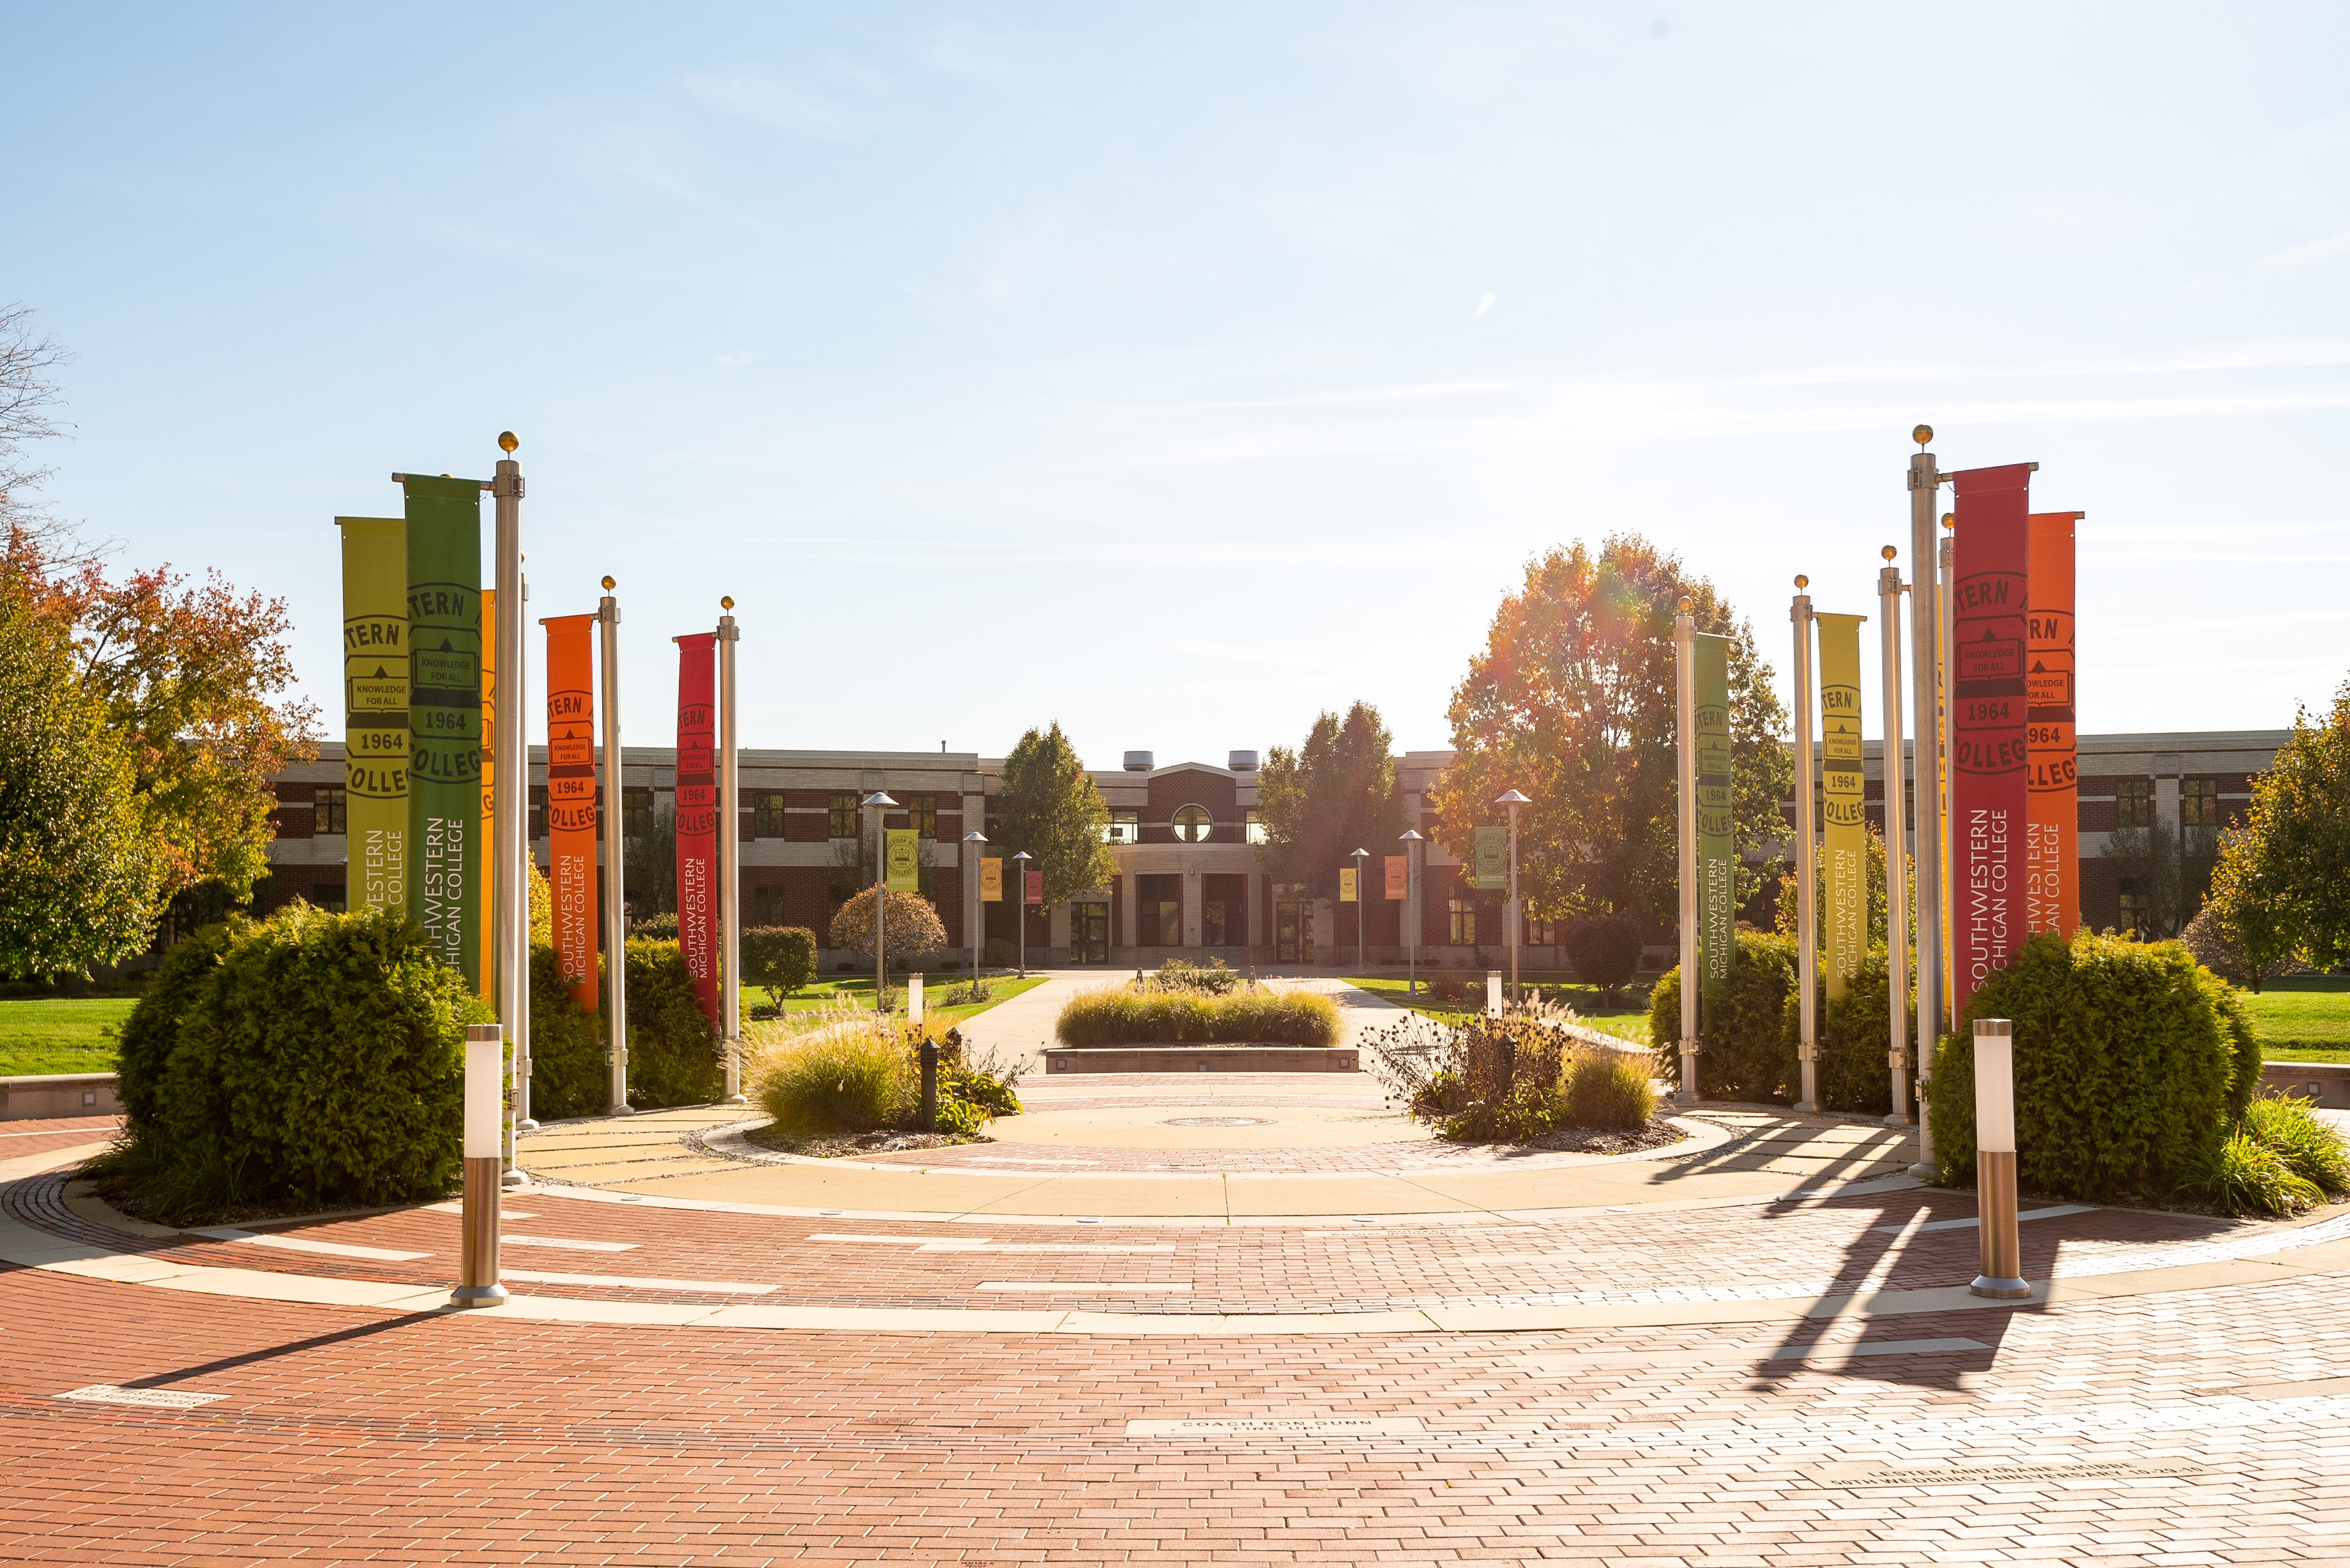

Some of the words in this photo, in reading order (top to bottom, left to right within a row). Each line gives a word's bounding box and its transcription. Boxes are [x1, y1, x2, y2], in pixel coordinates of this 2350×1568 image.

[421, 658, 471, 670] KNOWLEDGE
[431, 671, 447, 681] FOR
[448, 672, 461, 682] ALL
[1964, 649, 2014, 659] KNOWLEDGE
[1973, 663, 1989, 672] FOR
[1990, 662, 2004, 670] ALL
[357, 685, 406, 693] KNOWLEDGE
[1967, 702, 2010, 721] 1964
[2028, 679, 2064, 688] OWLEDGE
[361, 734, 403, 750] 1964
[426, 712, 466, 731] 1964
[2029, 727, 2060, 743] 964
[346, 762, 409, 792] OLLE
[557, 781, 584, 794] 1964
[683, 788, 705, 801] 1964
[1706, 789, 1726, 801] 1964
[1831, 775, 1856, 788] 1964
[367, 831, 383, 912] ESTERN
[388, 831, 403, 905] COLLEGE
[448, 818, 462, 901] COLLEGE
[1847, 850, 1856, 908] COLLEGE
[1992, 810, 2007, 892] COLLEGE
[2028, 824, 2040, 933] HWESTERN
[2044, 824, 2059, 898] COLLEGE
[424, 818, 443, 961] HWESTERN
[574, 856, 584, 913] COLLEGE
[697, 858, 705, 912] COLLEGE
[1718, 859, 1727, 914] COLLEGE
[1971, 810, 1988, 993] SOUTHWESTERN
[446, 907, 461, 976] HIGAN
[560, 856, 574, 983] SOUTHWESTERN
[685, 858, 698, 978] SOUTHWESTERN
[1708, 859, 1718, 979] SOUTHWESTERN
[1835, 850, 1847, 978] SOUTHWESTERN
[1992, 898, 2007, 972] CHIGAN
[575, 917, 586, 984] MICHIGAN
[697, 916, 707, 978] MICHIGAN
[1719, 917, 1727, 979] MICHIGAN
[1848, 912, 1857, 979] MICHIGAN
[101, 1394, 201, 1405] SUPERHEROES
[146, 1392, 220, 1401] BROTHERS
[1983, 1471, 2125, 1481] ANNIVERSARY
